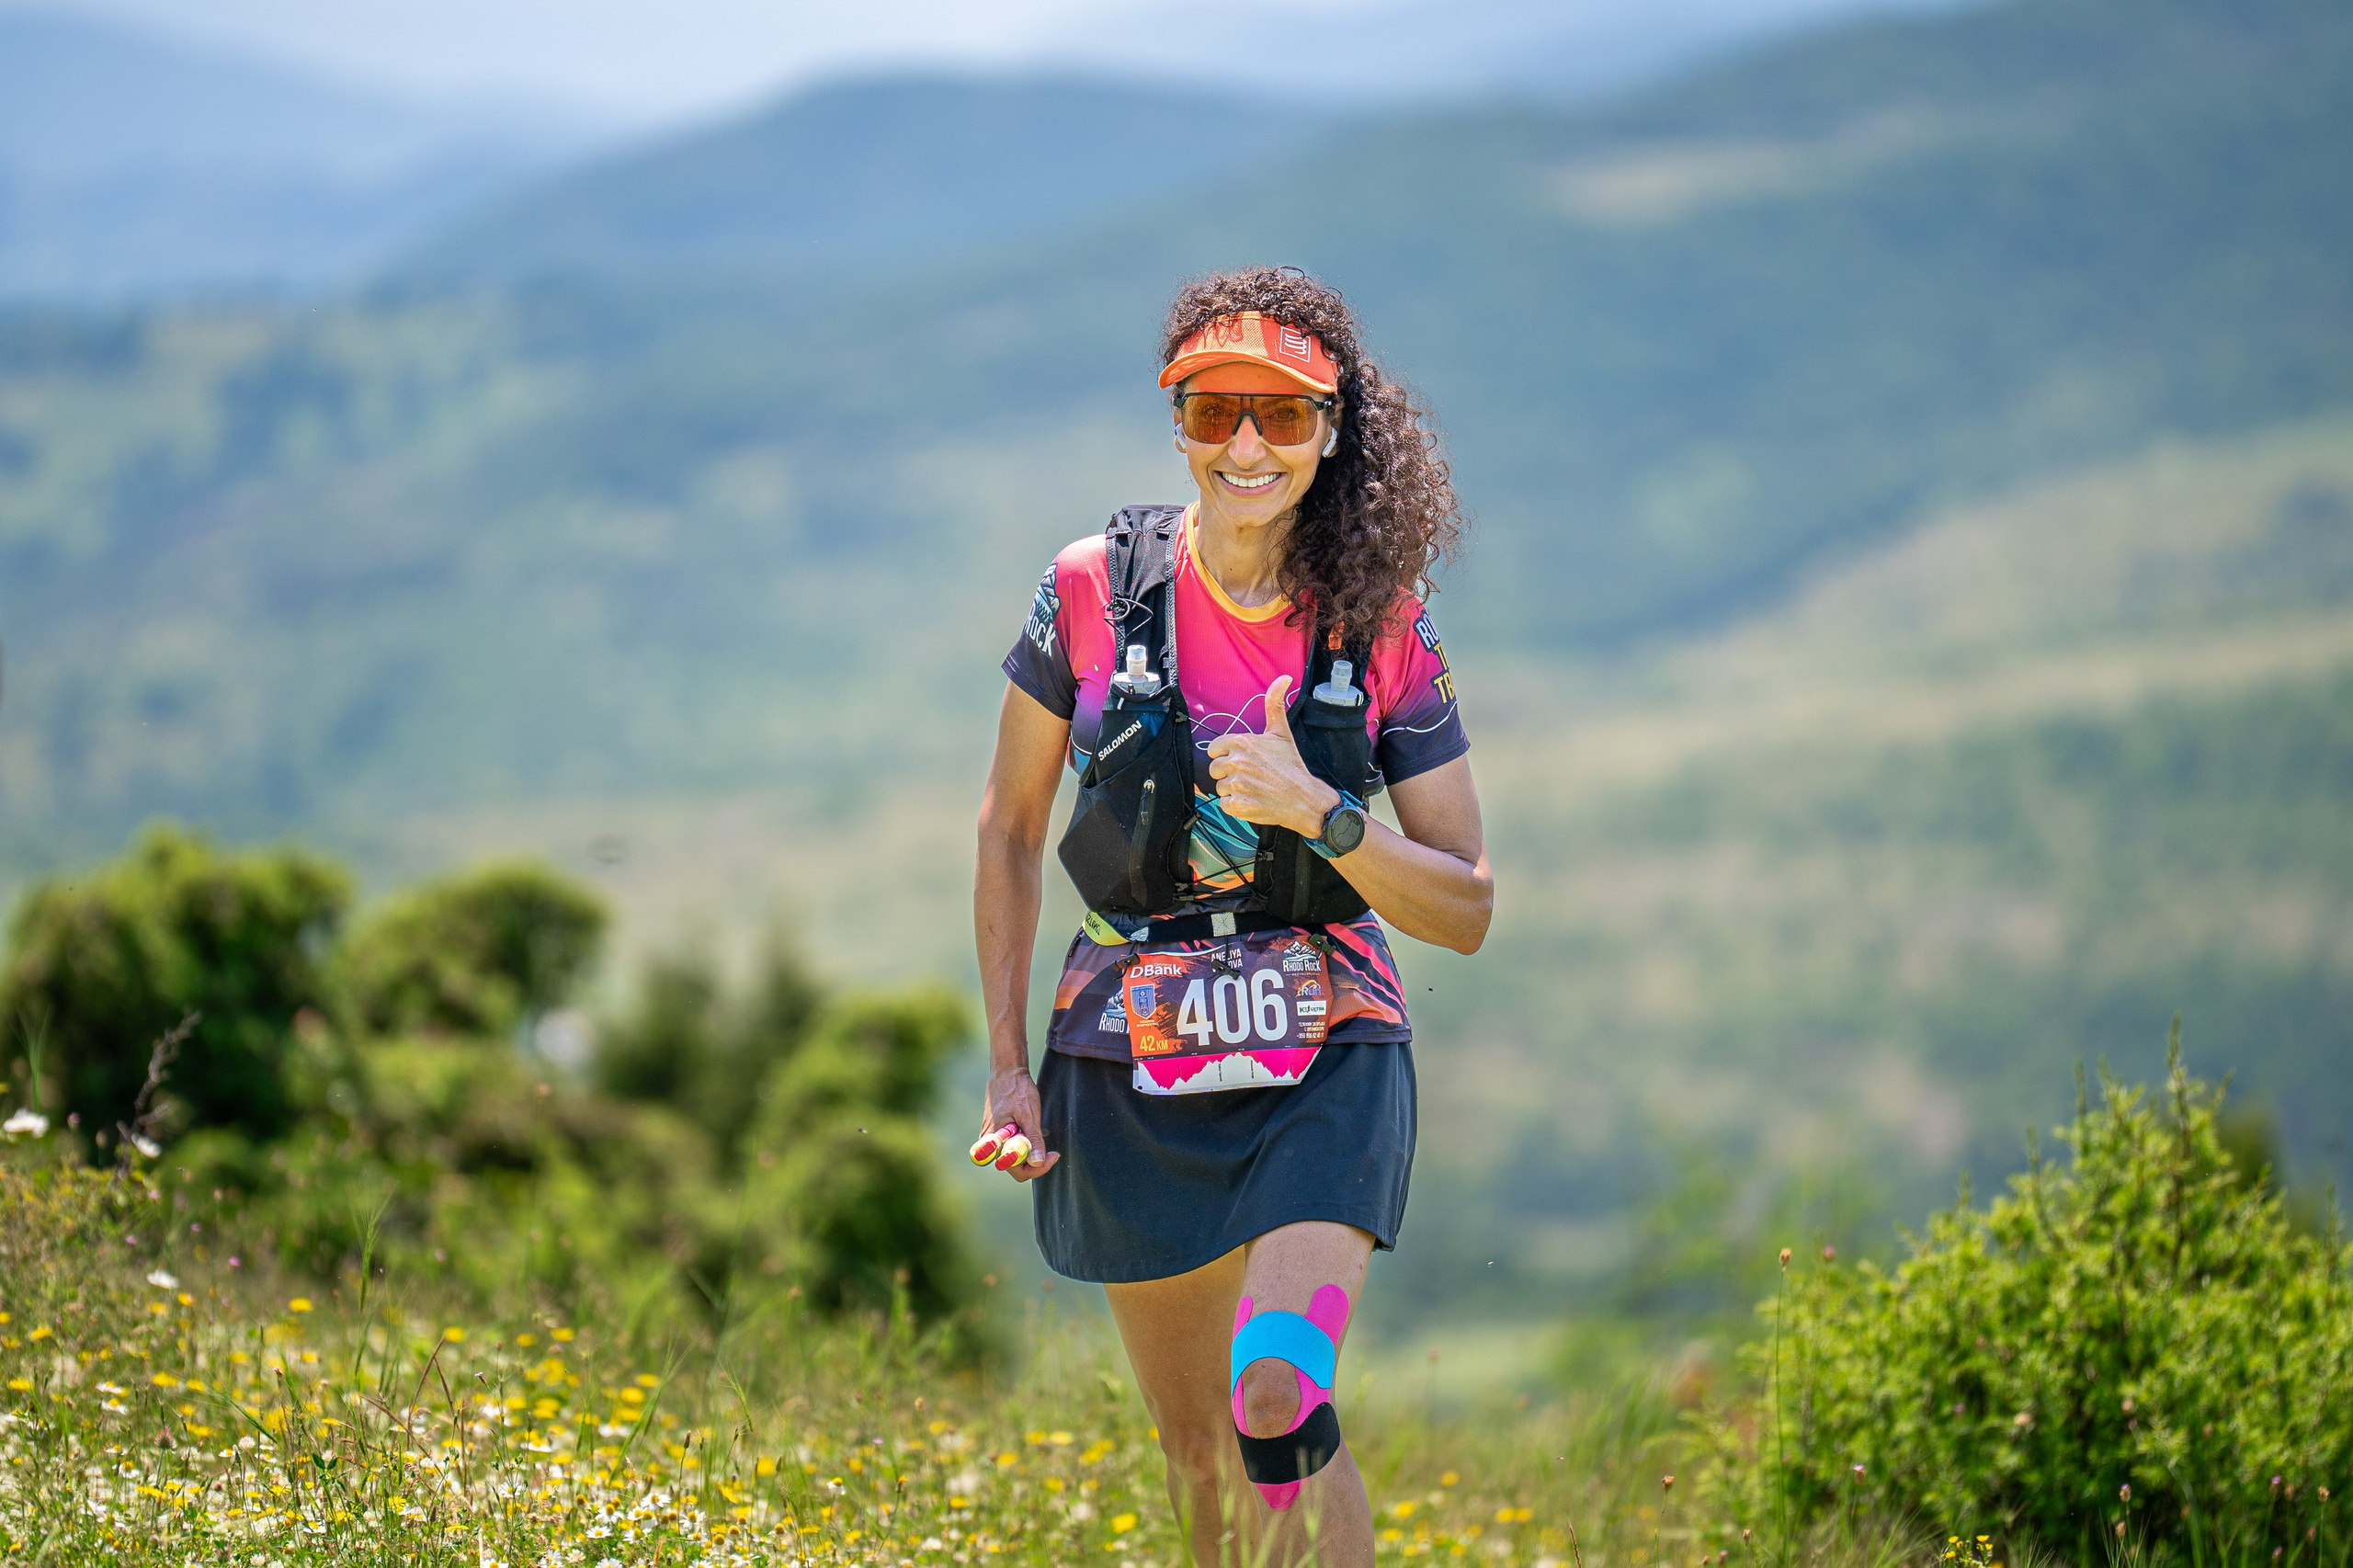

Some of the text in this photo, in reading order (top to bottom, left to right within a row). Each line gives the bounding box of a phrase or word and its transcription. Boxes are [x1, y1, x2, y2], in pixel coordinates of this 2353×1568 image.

[1098, 720, 1142, 761] SALOMON
[1211, 949, 1242, 962] ANEIYA
[1130, 963, 1182, 979] DBank
[1176, 969, 1289, 1046] 406
[1140, 1035, 1168, 1052] 42 KM
